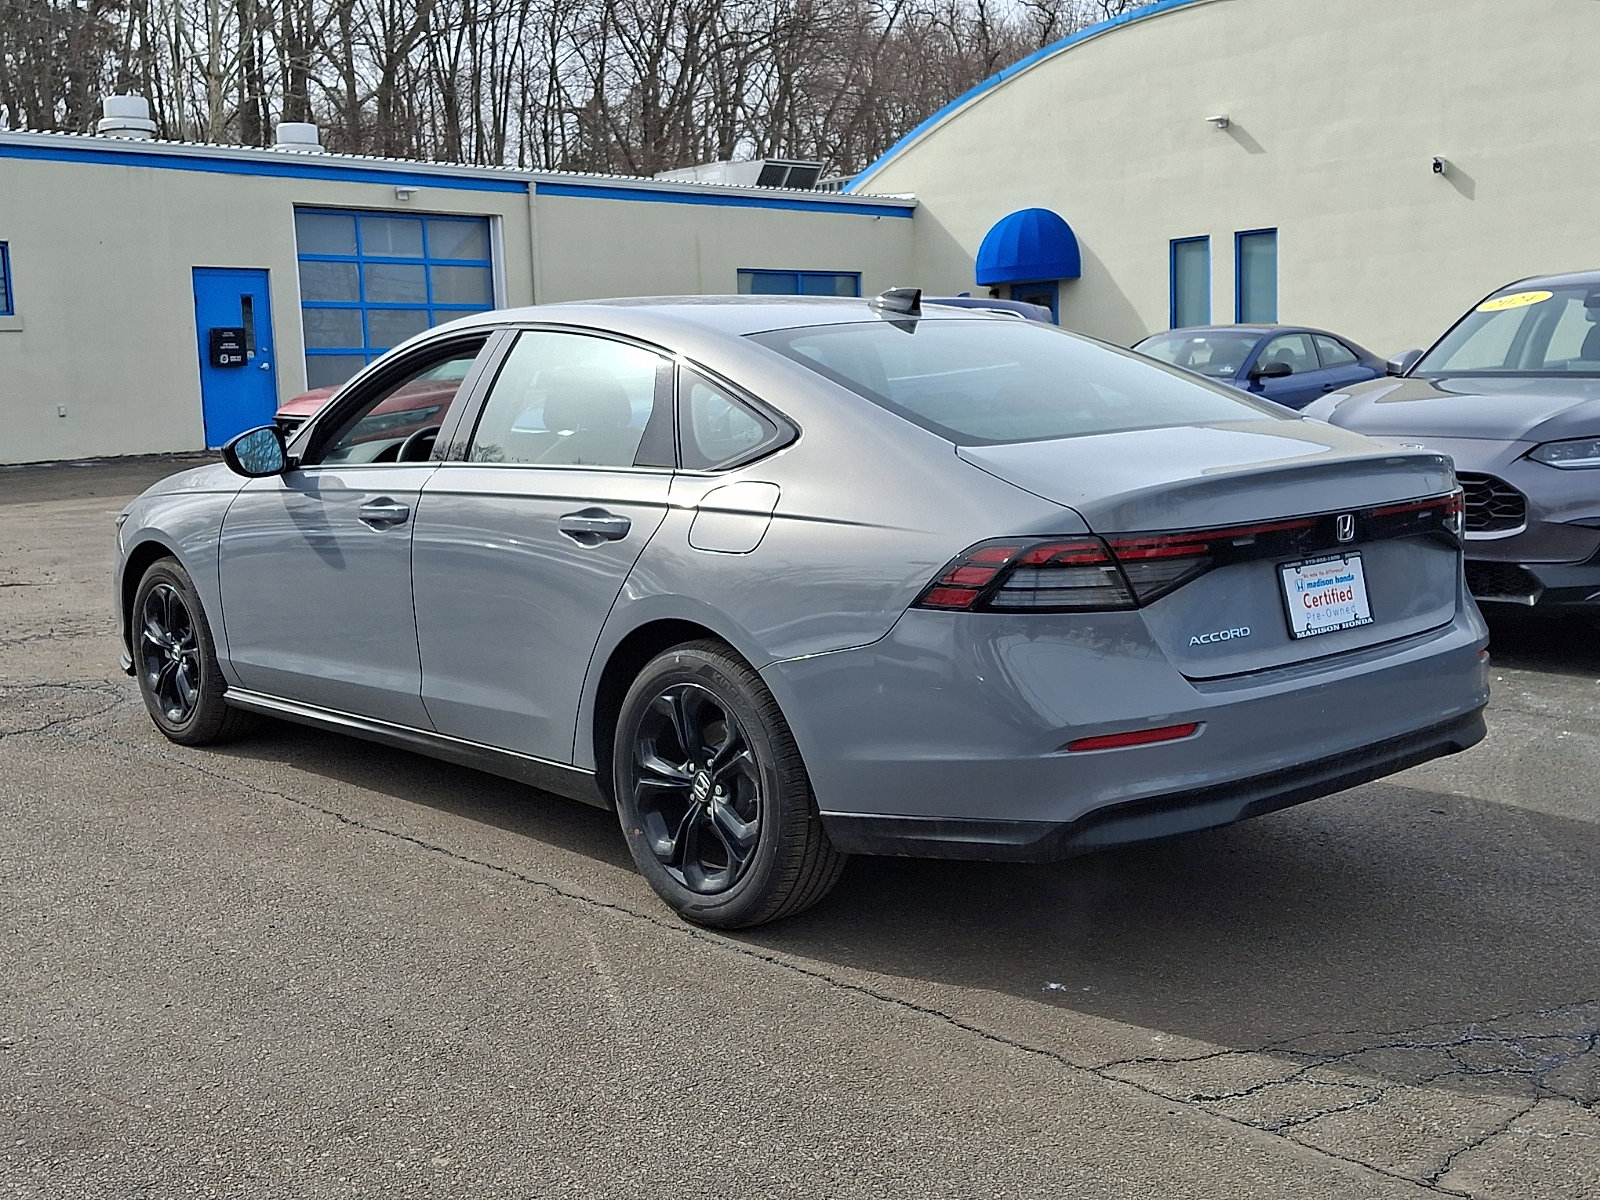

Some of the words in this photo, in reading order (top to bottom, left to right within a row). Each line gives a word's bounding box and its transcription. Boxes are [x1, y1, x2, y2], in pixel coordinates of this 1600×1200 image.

[1306, 577, 1333, 589] madison
[1335, 573, 1355, 583] honda
[1303, 585, 1353, 608] Certified
[1307, 604, 1356, 621] Pre-Owned
[1188, 626, 1251, 647] ACCORD
[1296, 623, 1341, 639] MADISON
[1341, 617, 1374, 629] HONDA
